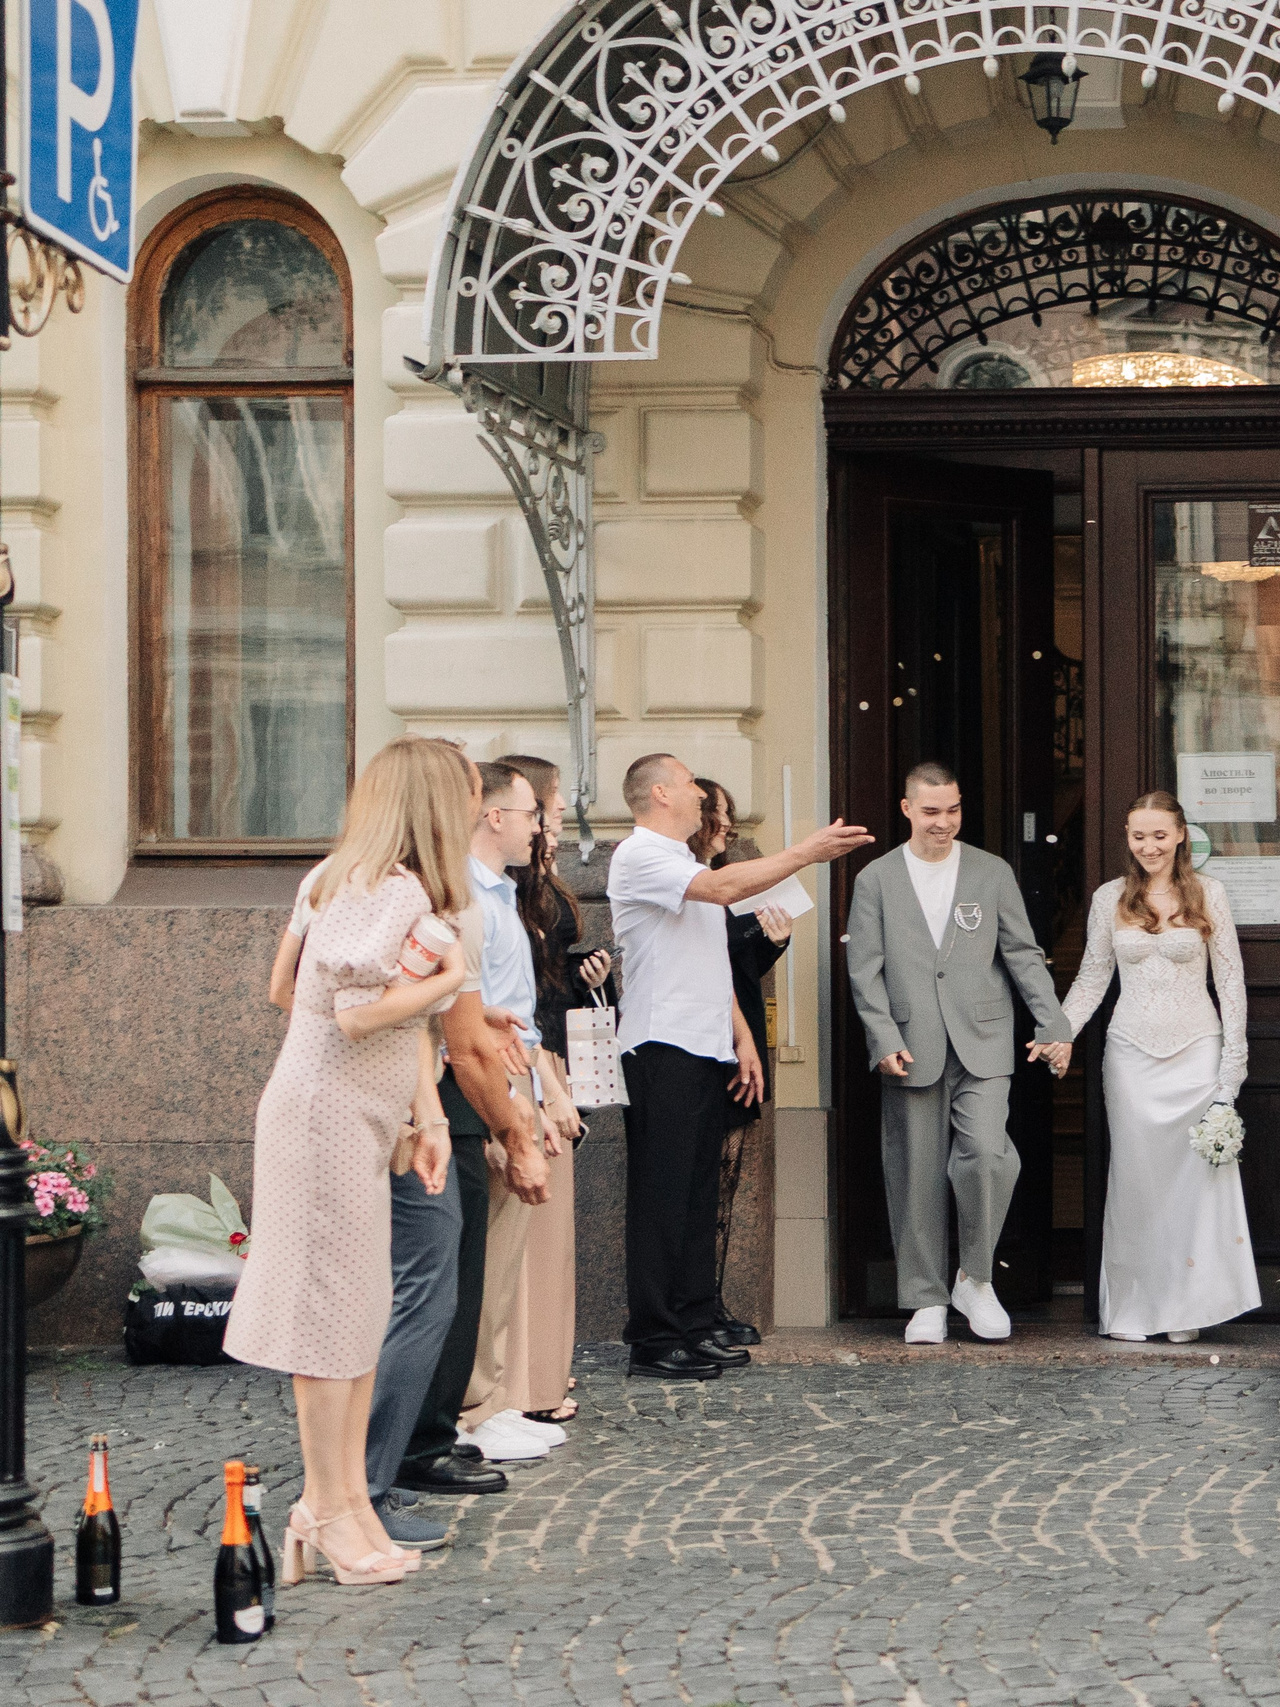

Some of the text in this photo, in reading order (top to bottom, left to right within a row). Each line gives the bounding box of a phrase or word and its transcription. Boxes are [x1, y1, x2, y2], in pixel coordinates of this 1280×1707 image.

[57, 0, 115, 203] P
[1201, 769, 1255, 778] Апостиль
[1204, 785, 1253, 796] во дворе
[154, 1301, 234, 1318] ПИЕРСКИ
